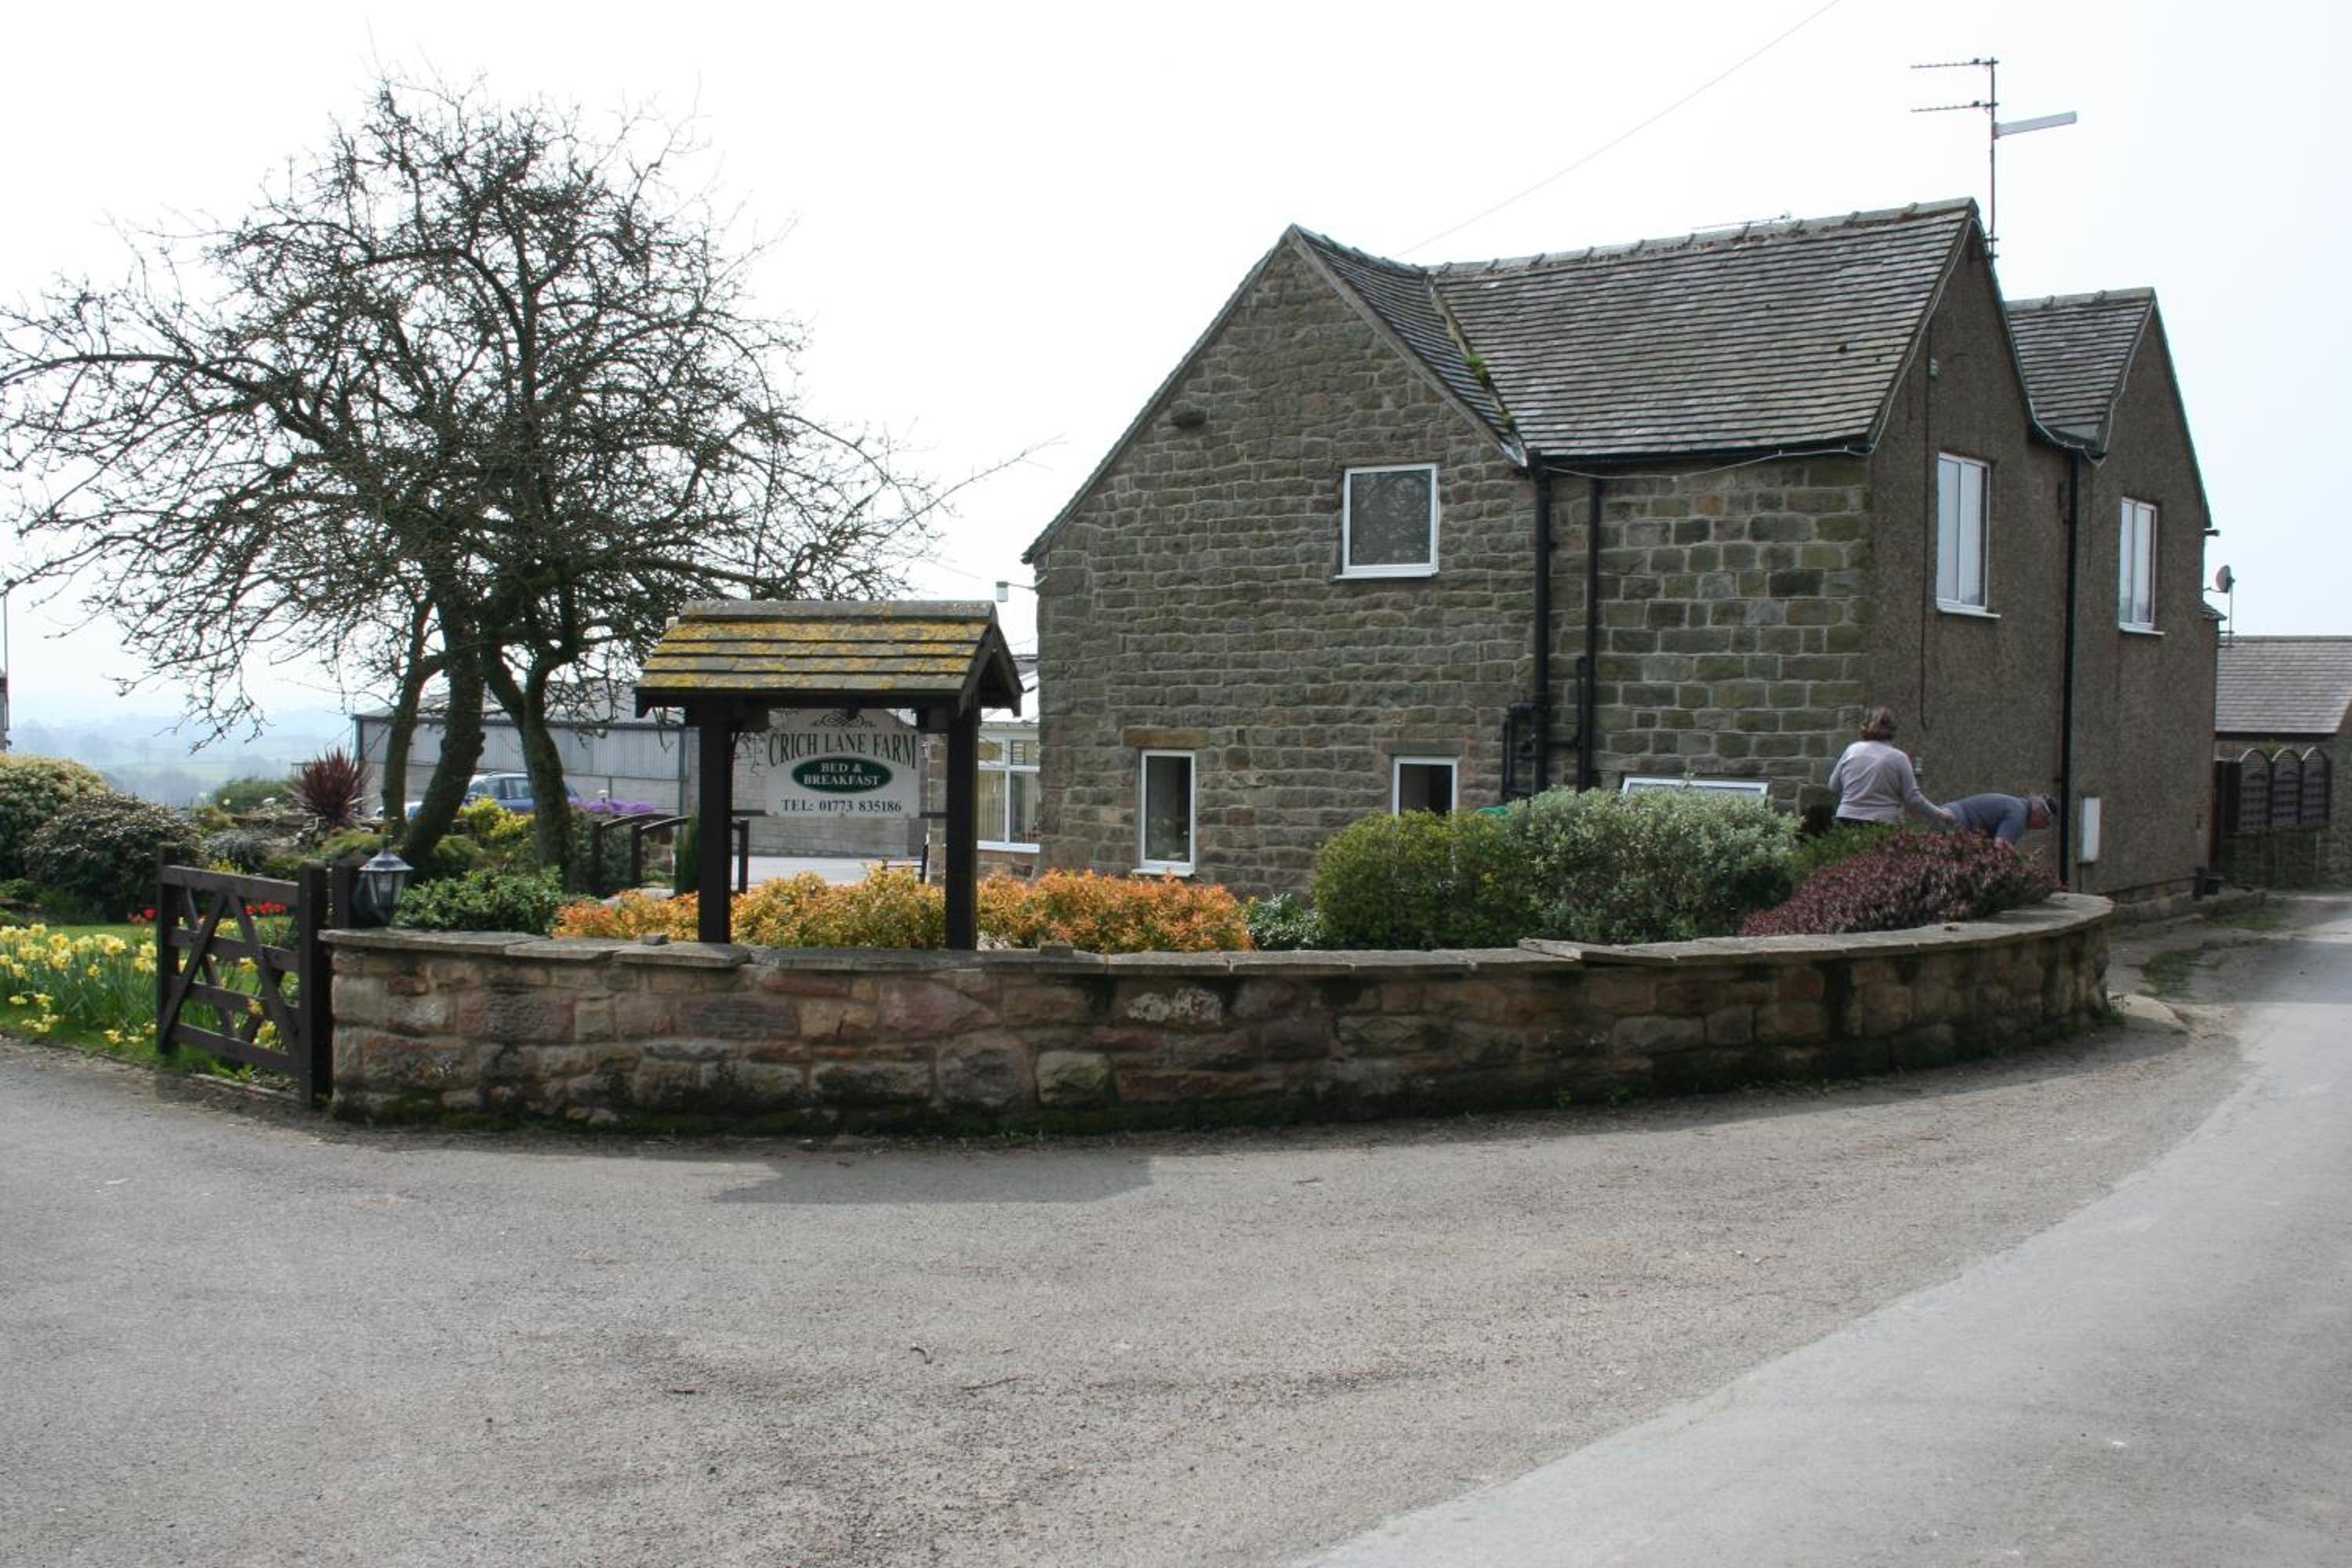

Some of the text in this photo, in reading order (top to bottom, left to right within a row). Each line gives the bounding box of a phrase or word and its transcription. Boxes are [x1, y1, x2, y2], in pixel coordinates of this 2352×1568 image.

[769, 732, 916, 769] CRICH LANE FARM
[822, 763, 862, 772] BED &
[804, 775, 880, 785] BREAKFAST
[781, 800, 813, 811] TEL:
[819, 800, 853, 811] 01773
